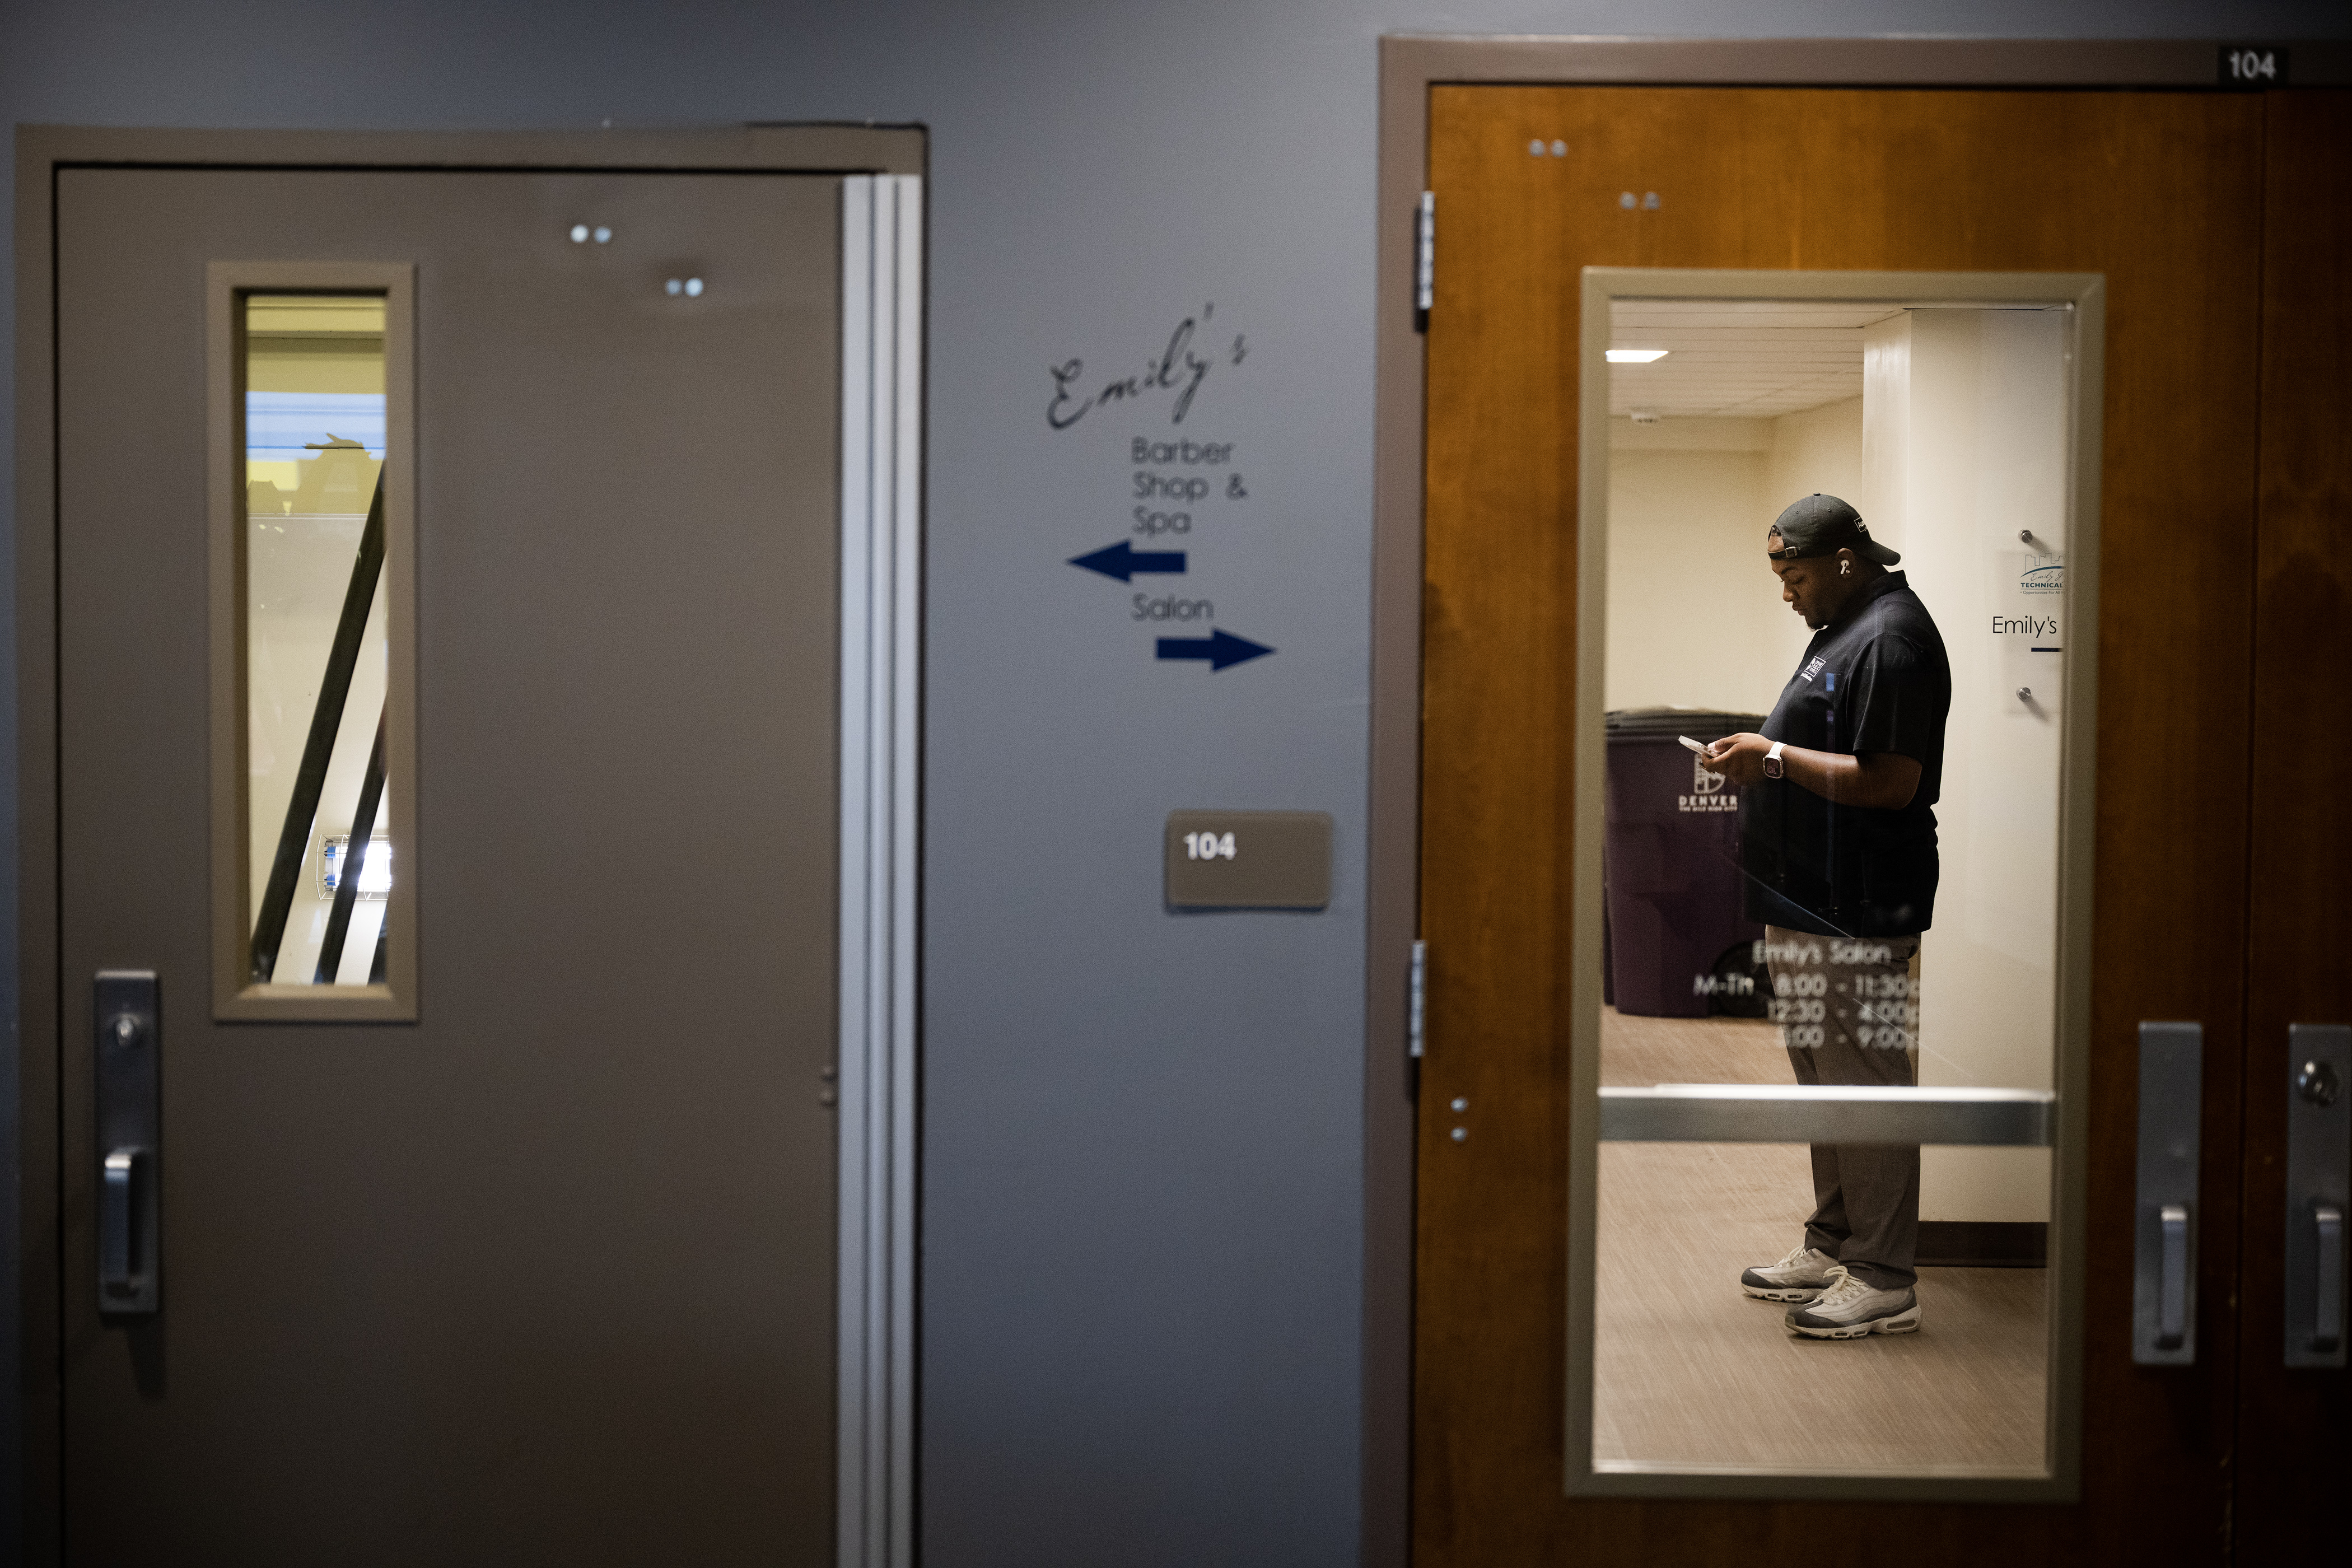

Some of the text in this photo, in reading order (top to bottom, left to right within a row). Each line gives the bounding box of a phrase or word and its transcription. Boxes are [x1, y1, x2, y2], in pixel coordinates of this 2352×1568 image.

[2229, 49, 2276, 80] 104
[1046, 301, 1249, 431] Emily's
[1131, 437, 1234, 465] Barber
[1132, 470, 1249, 505] Shop &
[1132, 505, 1191, 538] Spa
[2031, 571, 2054, 583] Emily
[1131, 592, 1214, 622] Salon
[1992, 615, 2057, 638] Emily's
[1679, 795, 1738, 806] DENVER
[1183, 832, 1237, 860] 104
[1830, 940, 1891, 964] Salon
